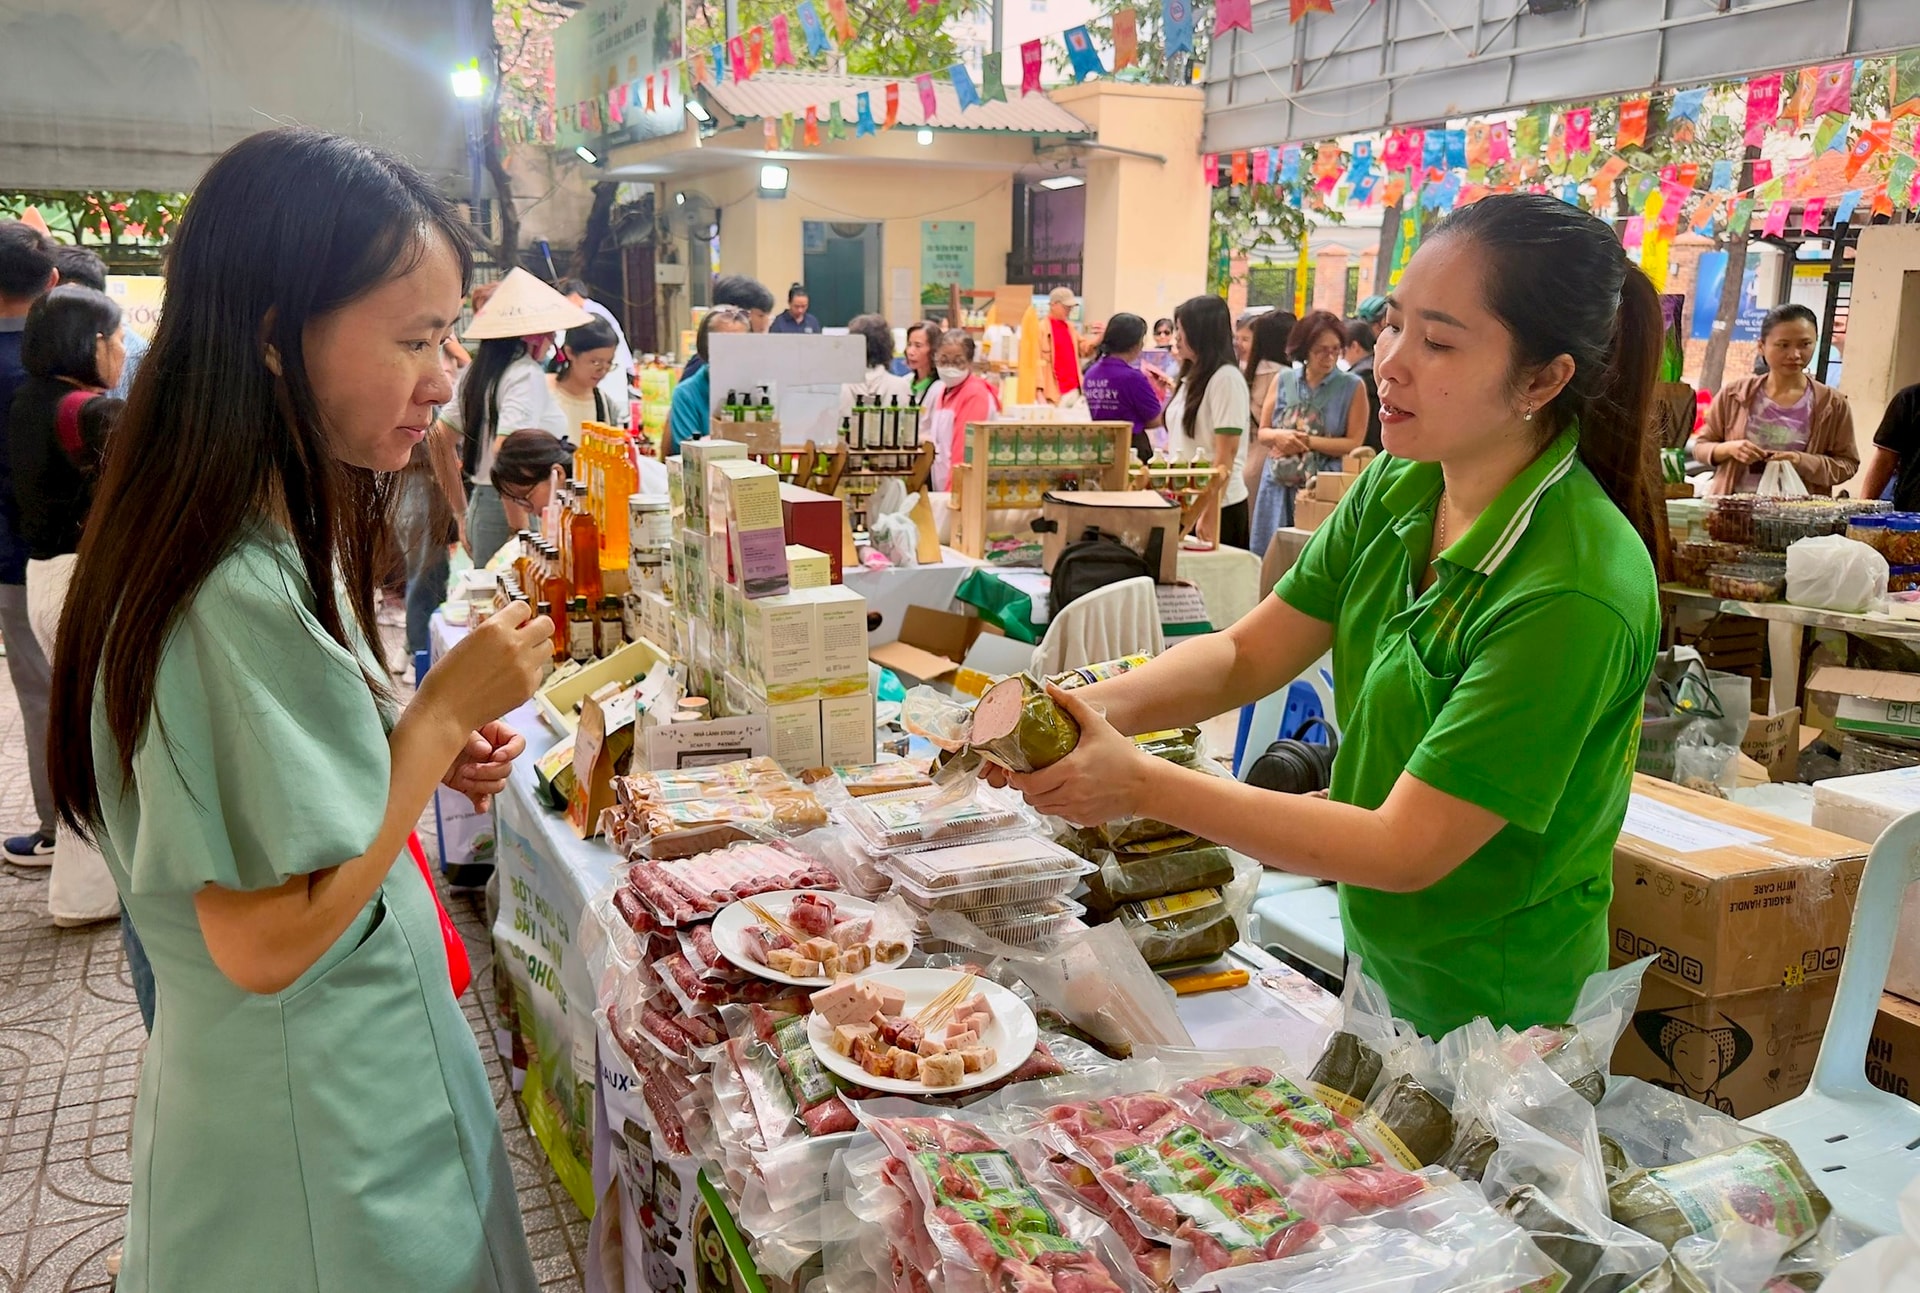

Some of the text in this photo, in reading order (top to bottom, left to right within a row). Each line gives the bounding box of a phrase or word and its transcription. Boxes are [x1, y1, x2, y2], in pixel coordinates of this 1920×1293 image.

[717, 740, 741, 748] PAYMENT
[1753, 880, 1796, 895] WITH CARE
[1729, 900, 1761, 912] HANDLE
